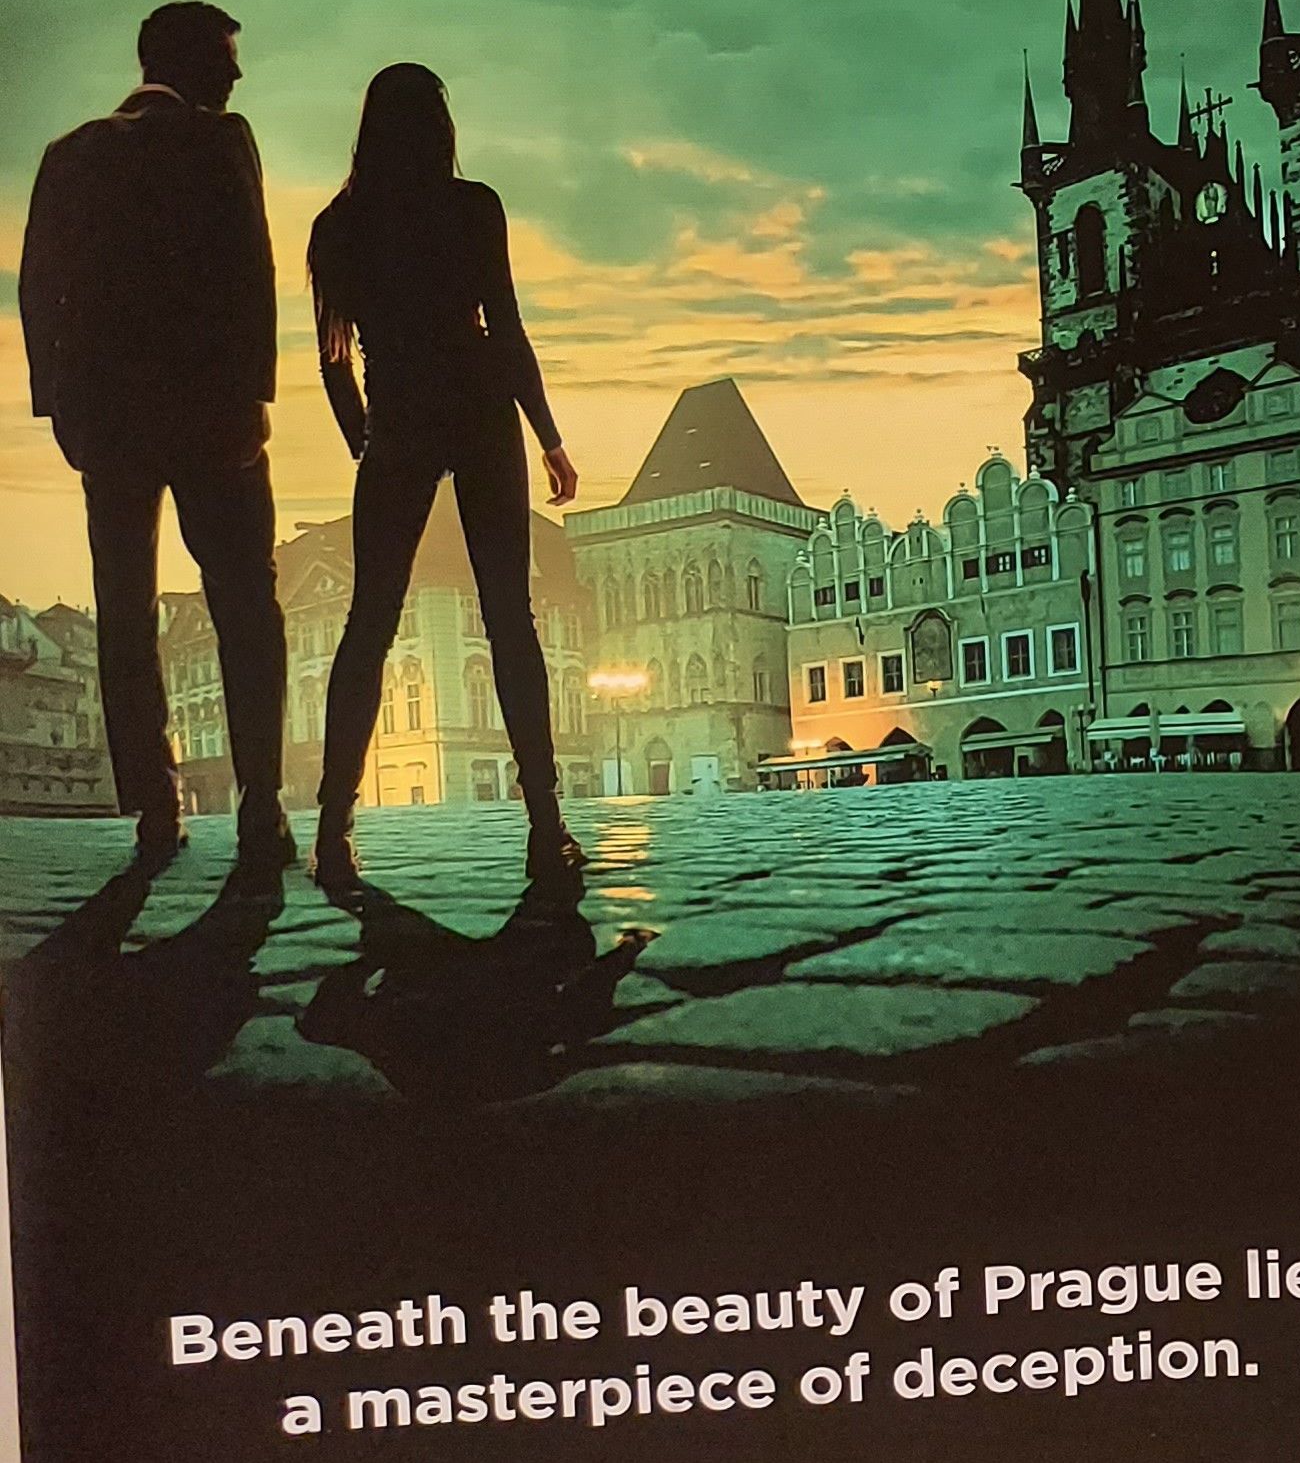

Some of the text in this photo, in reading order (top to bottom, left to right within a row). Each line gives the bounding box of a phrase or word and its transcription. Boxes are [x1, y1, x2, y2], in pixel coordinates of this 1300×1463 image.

[170, 1294, 467, 1366] Beneath
[489, 1290, 601, 1342] the
[625, 1280, 865, 1337] beauty
[889, 1267, 960, 1322] of
[984, 1262, 1222, 1315] Prague
[281, 1330, 1259, 1435] a masterpiece of deception.
